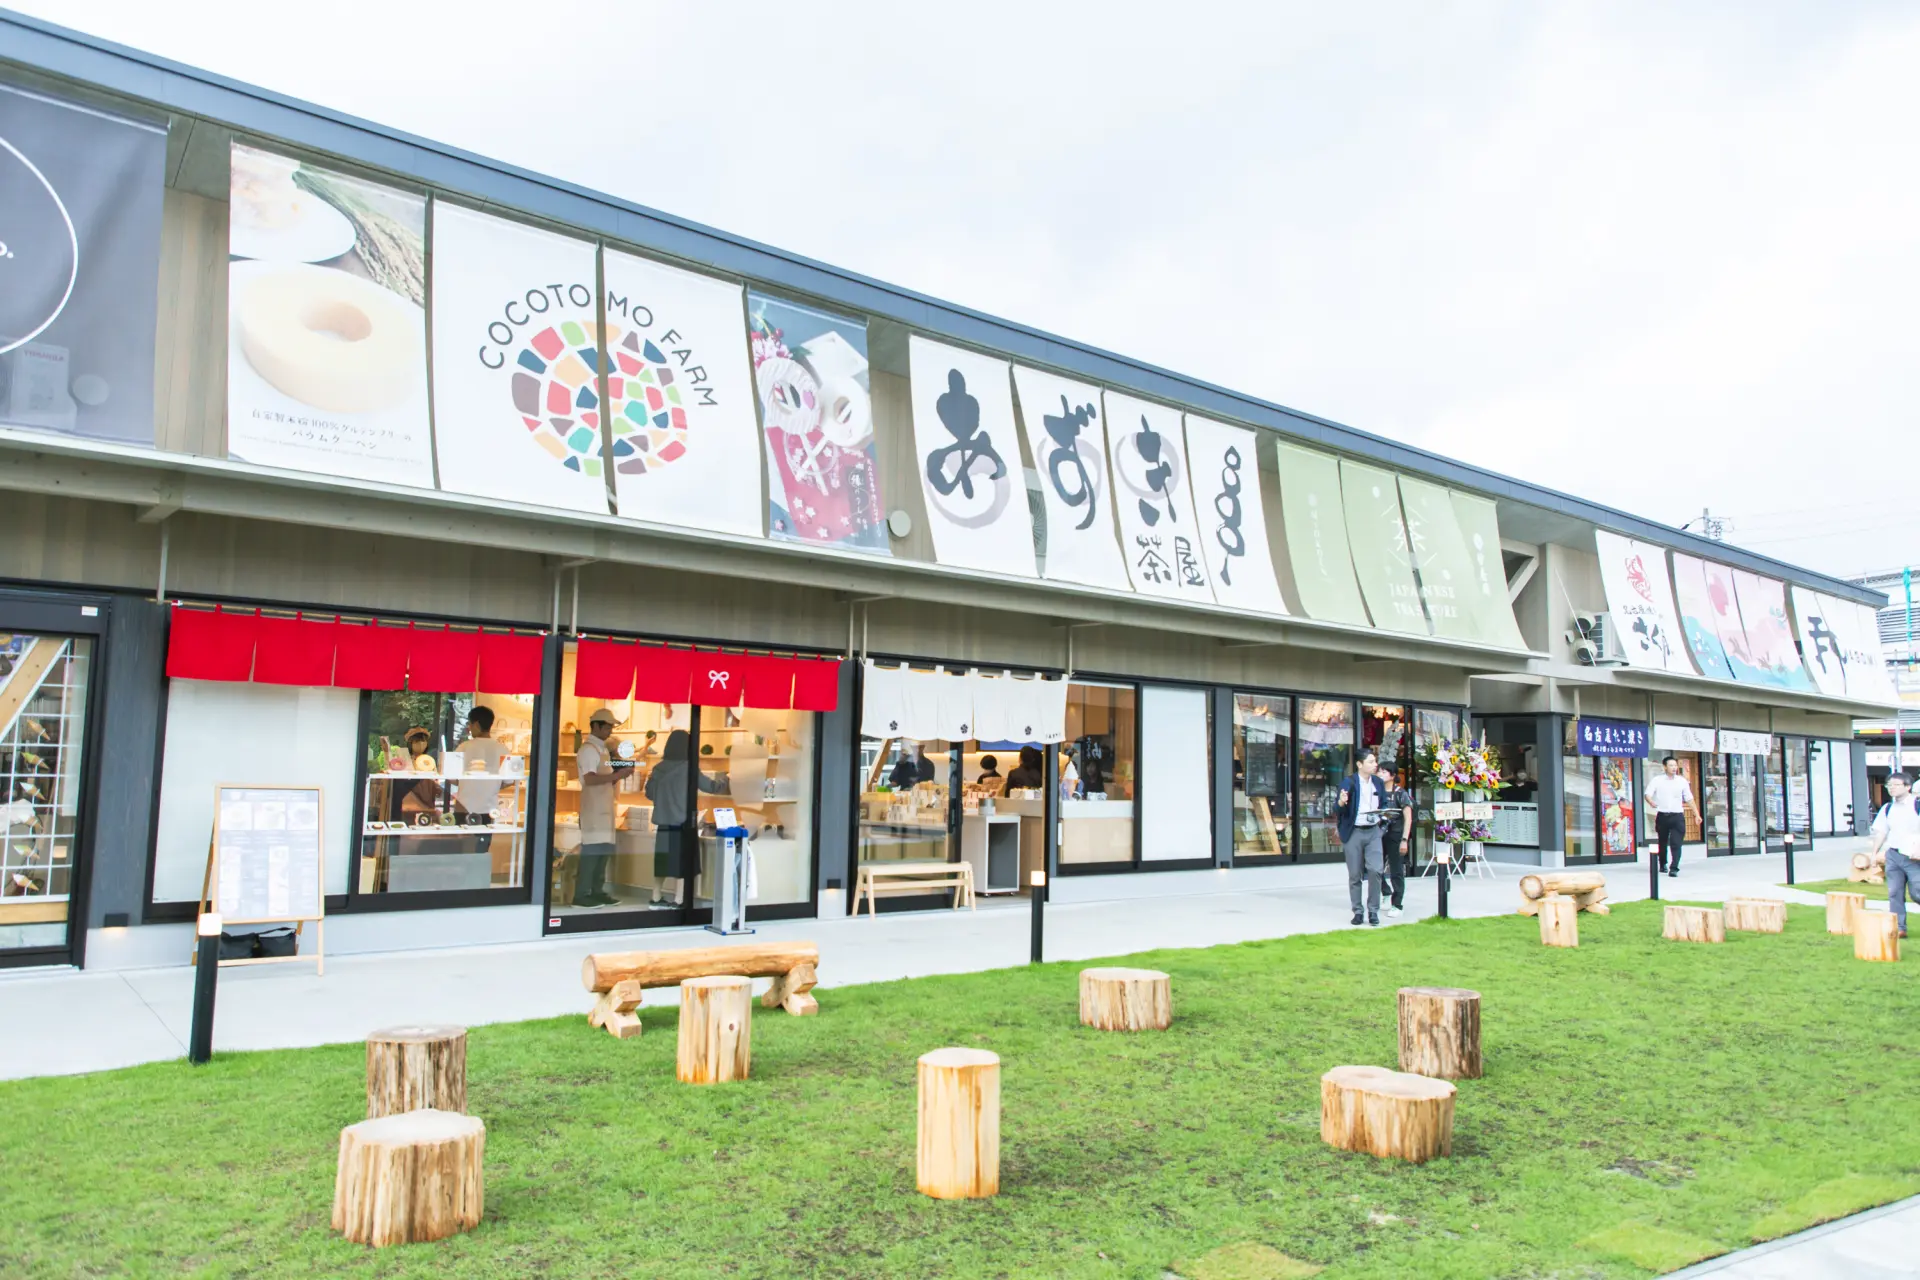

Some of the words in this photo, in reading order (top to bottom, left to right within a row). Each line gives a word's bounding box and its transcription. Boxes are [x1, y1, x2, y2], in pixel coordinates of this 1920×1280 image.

[660, 328, 718, 405] FARM
[1135, 533, 1205, 588] 茶屋
[1583, 725, 1644, 745] 名古屋たこ焼き
